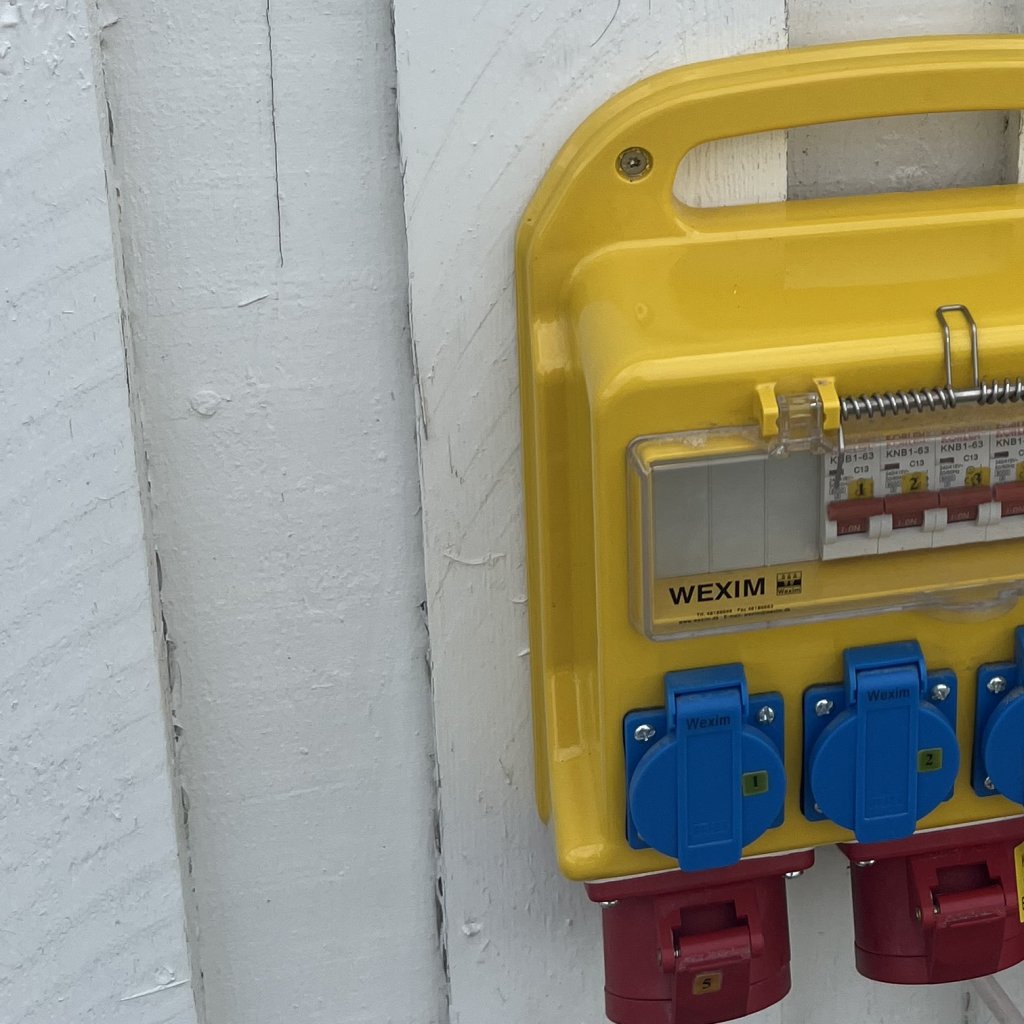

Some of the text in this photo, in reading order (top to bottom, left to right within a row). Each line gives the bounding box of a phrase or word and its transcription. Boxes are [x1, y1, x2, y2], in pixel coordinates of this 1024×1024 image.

[886, 446, 930, 458] KNB1-63
[940, 440, 984, 452] KNB1-63
[830, 452, 874, 464] KB1-63
[910, 460, 924, 468] C13
[964, 454, 978, 462] C13
[854, 466, 870, 474] C13
[669, 577, 765, 605] WEXIM
[867, 687, 910, 702] Wexim
[686, 714, 731, 730] Wexim
[925, 754, 934, 765] 2
[702, 978, 712, 990] 5
